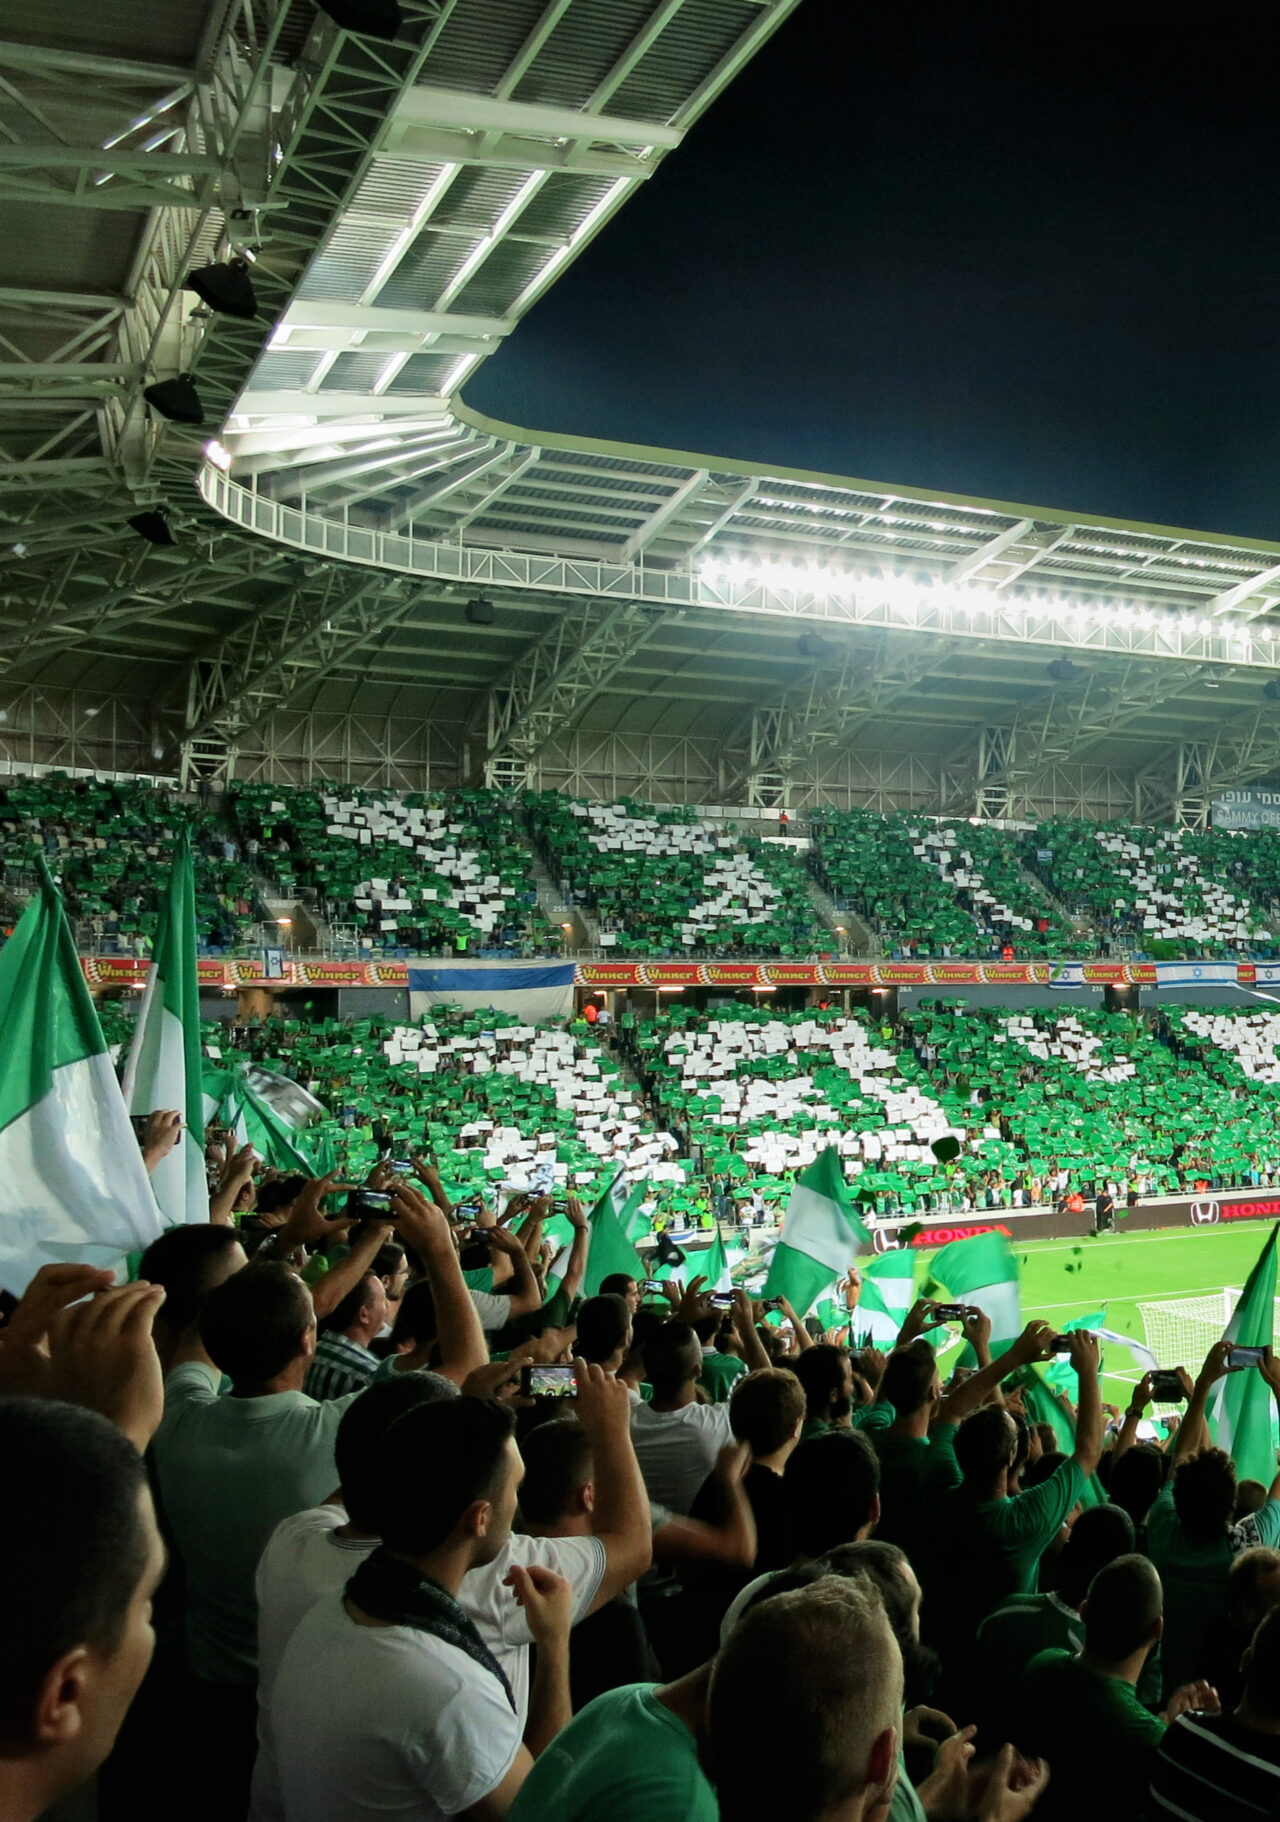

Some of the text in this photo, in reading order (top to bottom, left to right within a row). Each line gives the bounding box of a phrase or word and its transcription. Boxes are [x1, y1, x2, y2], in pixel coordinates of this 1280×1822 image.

[1217, 810, 1259, 823] SAMMY
[238, 966, 290, 979] Winr
[306, 966, 360, 980] Winner
[583, 968, 631, 980] Winner
[647, 968, 693, 980] Winner
[708, 968, 752, 980] Winner
[767, 968, 811, 980] Winner
[825, 968, 866, 980] Winner
[880, 968, 920, 979] Winner
[933, 968, 973, 979] Winner
[985, 968, 1023, 979] Winner
[1084, 967, 1120, 979] Winner
[1132, 968, 1156, 979] Winn
